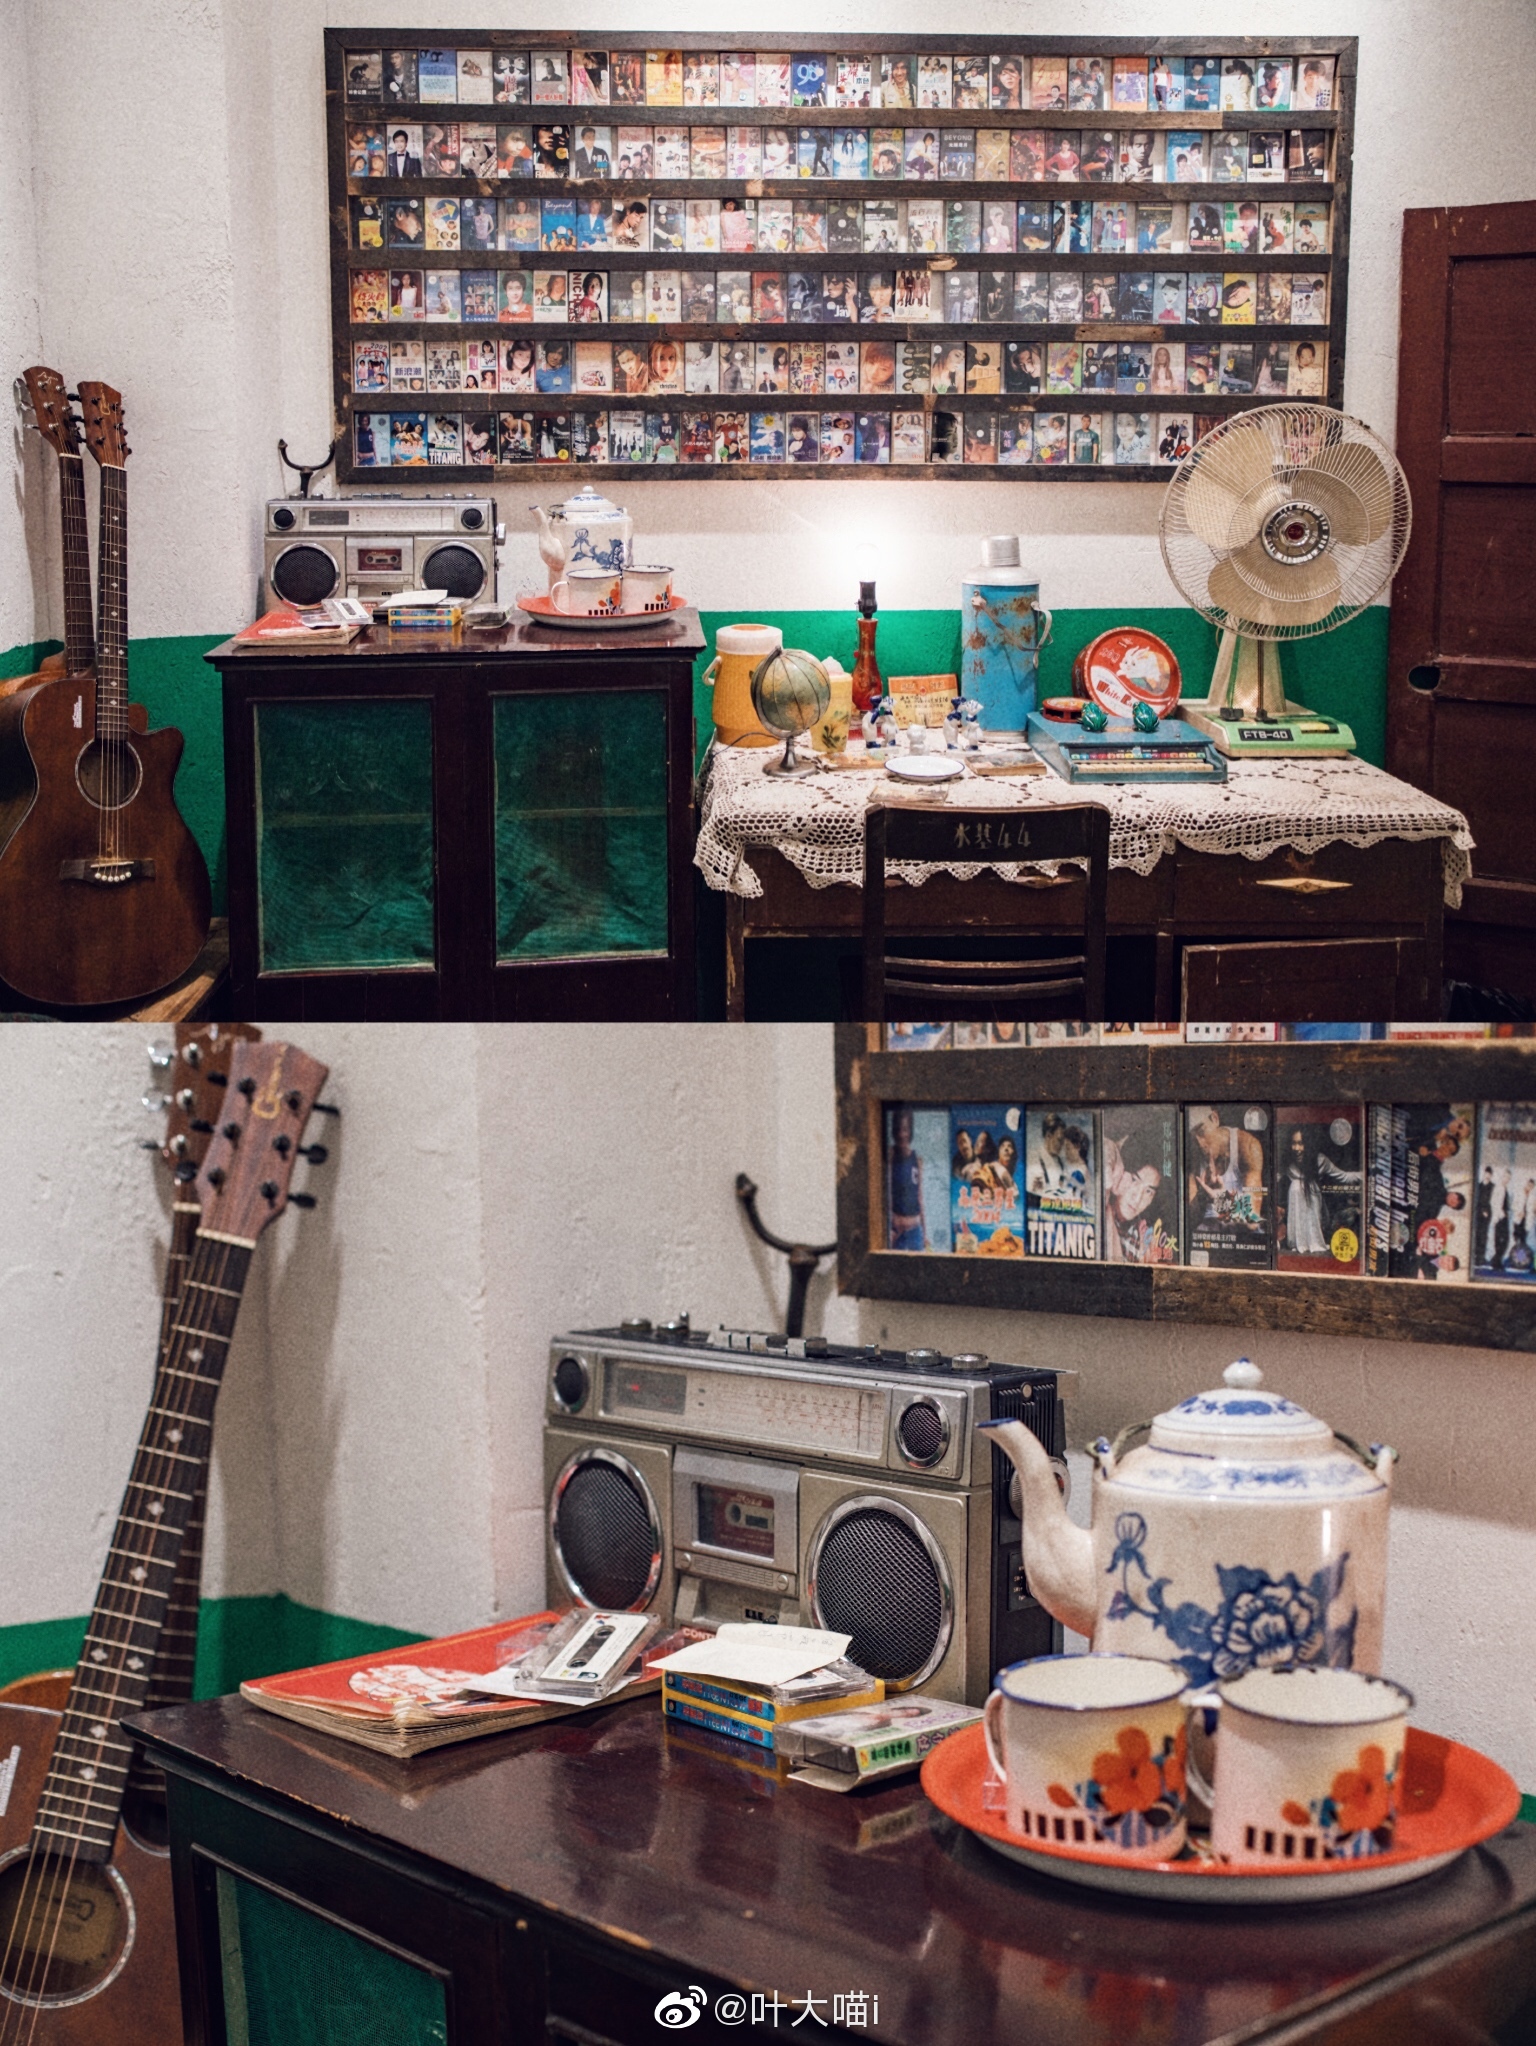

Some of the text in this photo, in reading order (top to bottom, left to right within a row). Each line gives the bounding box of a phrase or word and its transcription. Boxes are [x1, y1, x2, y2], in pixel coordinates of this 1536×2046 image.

[544, 200, 573, 210] Beyond
[834, 304, 850, 318] Jay
[370, 342, 388, 351] 2002
[1096, 680, 1121, 700] White
